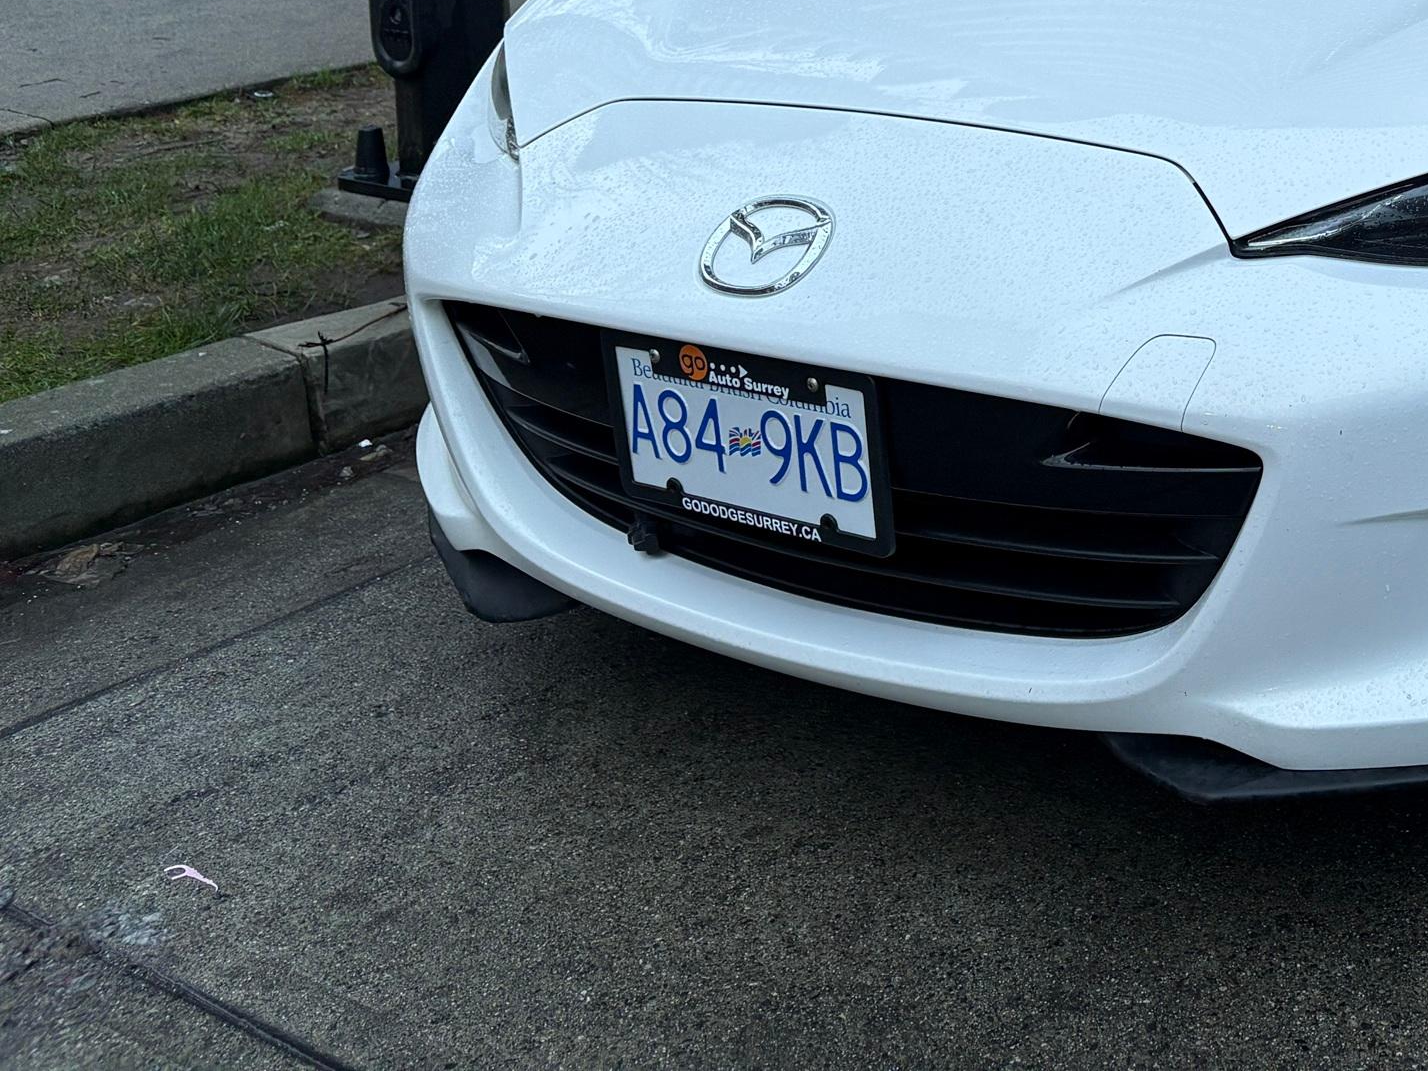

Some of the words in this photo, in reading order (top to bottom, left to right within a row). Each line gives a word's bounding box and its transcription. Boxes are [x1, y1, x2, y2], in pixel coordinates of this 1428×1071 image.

[681, 354, 706, 376] go
[708, 370, 741, 388] Auto
[743, 377, 790, 400] Surrey
[632, 383, 727, 473] A84
[760, 410, 869, 502] 9KB
[681, 497, 822, 542] GODODGESURREY.CA
